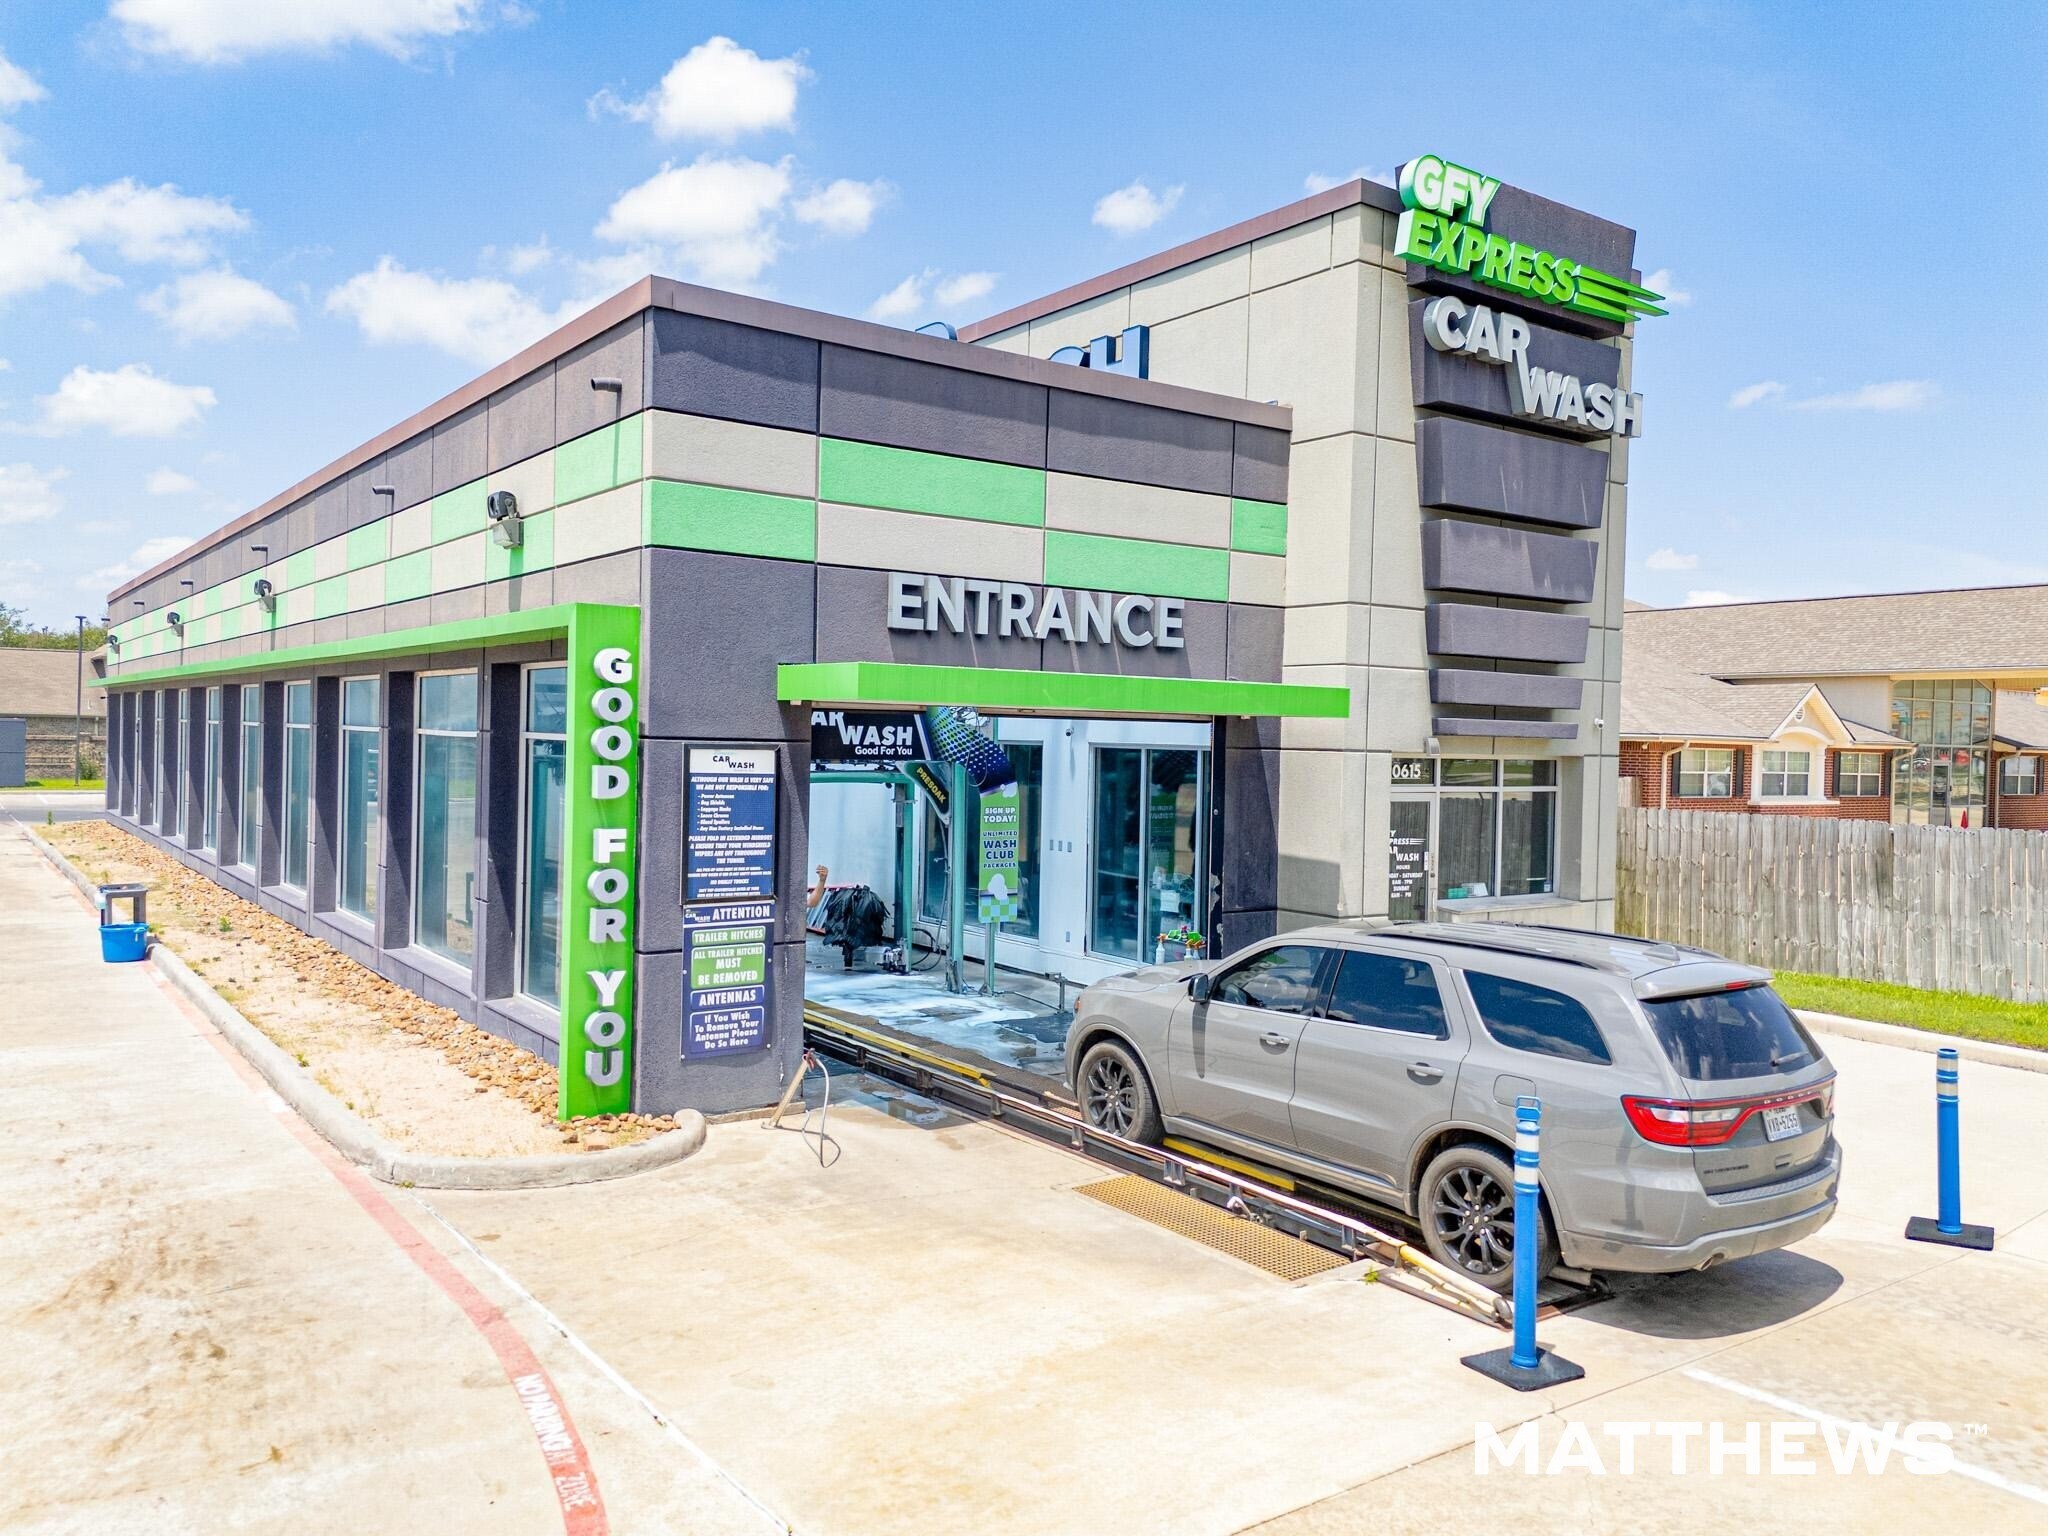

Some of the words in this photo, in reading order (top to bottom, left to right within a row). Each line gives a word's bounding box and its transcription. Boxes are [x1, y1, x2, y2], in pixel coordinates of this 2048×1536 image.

[1400, 154, 1501, 227] GFY
[1395, 208, 1578, 304] EXPRESS
[1423, 296, 1531, 364] CAR
[1512, 364, 1643, 438] WASH
[887, 571, 1185, 648] ENTRANCE
[591, 647, 633, 800] GOOD
[811, 711, 844, 726] AR
[840, 725, 913, 746] WASH
[854, 746, 879, 756] Good
[880, 746, 896, 756] For
[896, 746, 912, 756] You
[1392, 764, 1421, 778] 0615
[916, 766, 946, 804] PRESOAK
[984, 815, 1016, 823] TODAY!
[984, 840, 1016, 848] WASH
[986, 850, 1014, 860] CLUB
[1396, 853, 1419, 861] WASH
[587, 828, 629, 943] FOR
[712, 906, 770, 920] ATTENTION
[694, 932, 728, 943] TRAILER
[730, 929, 764, 940] HITCHES
[694, 950, 706, 959] ALL
[708, 948, 734, 958] TRAILER
[736, 946, 762, 956] HITCHES
[716, 958, 742, 969] MUST
[698, 974, 710, 985] BE
[714, 970, 758, 984] REMOVED
[699, 990, 756, 1006] ANTENNAS
[704, 1014, 712, 1024] If
[714, 1014, 728, 1022] You
[730, 1011, 750, 1020] Wish
[584, 970, 626, 1087] YOU
[694, 1024, 704, 1032] To
[706, 1022, 738, 1032] Remove
[740, 1020, 760, 1028] Your
[696, 1032, 730, 1042] Antenna
[732, 1028, 758, 1038] Please
[704, 1041, 716, 1050] Do
[718, 1040, 728, 1048] So
[730, 1038, 748, 1046] Here
